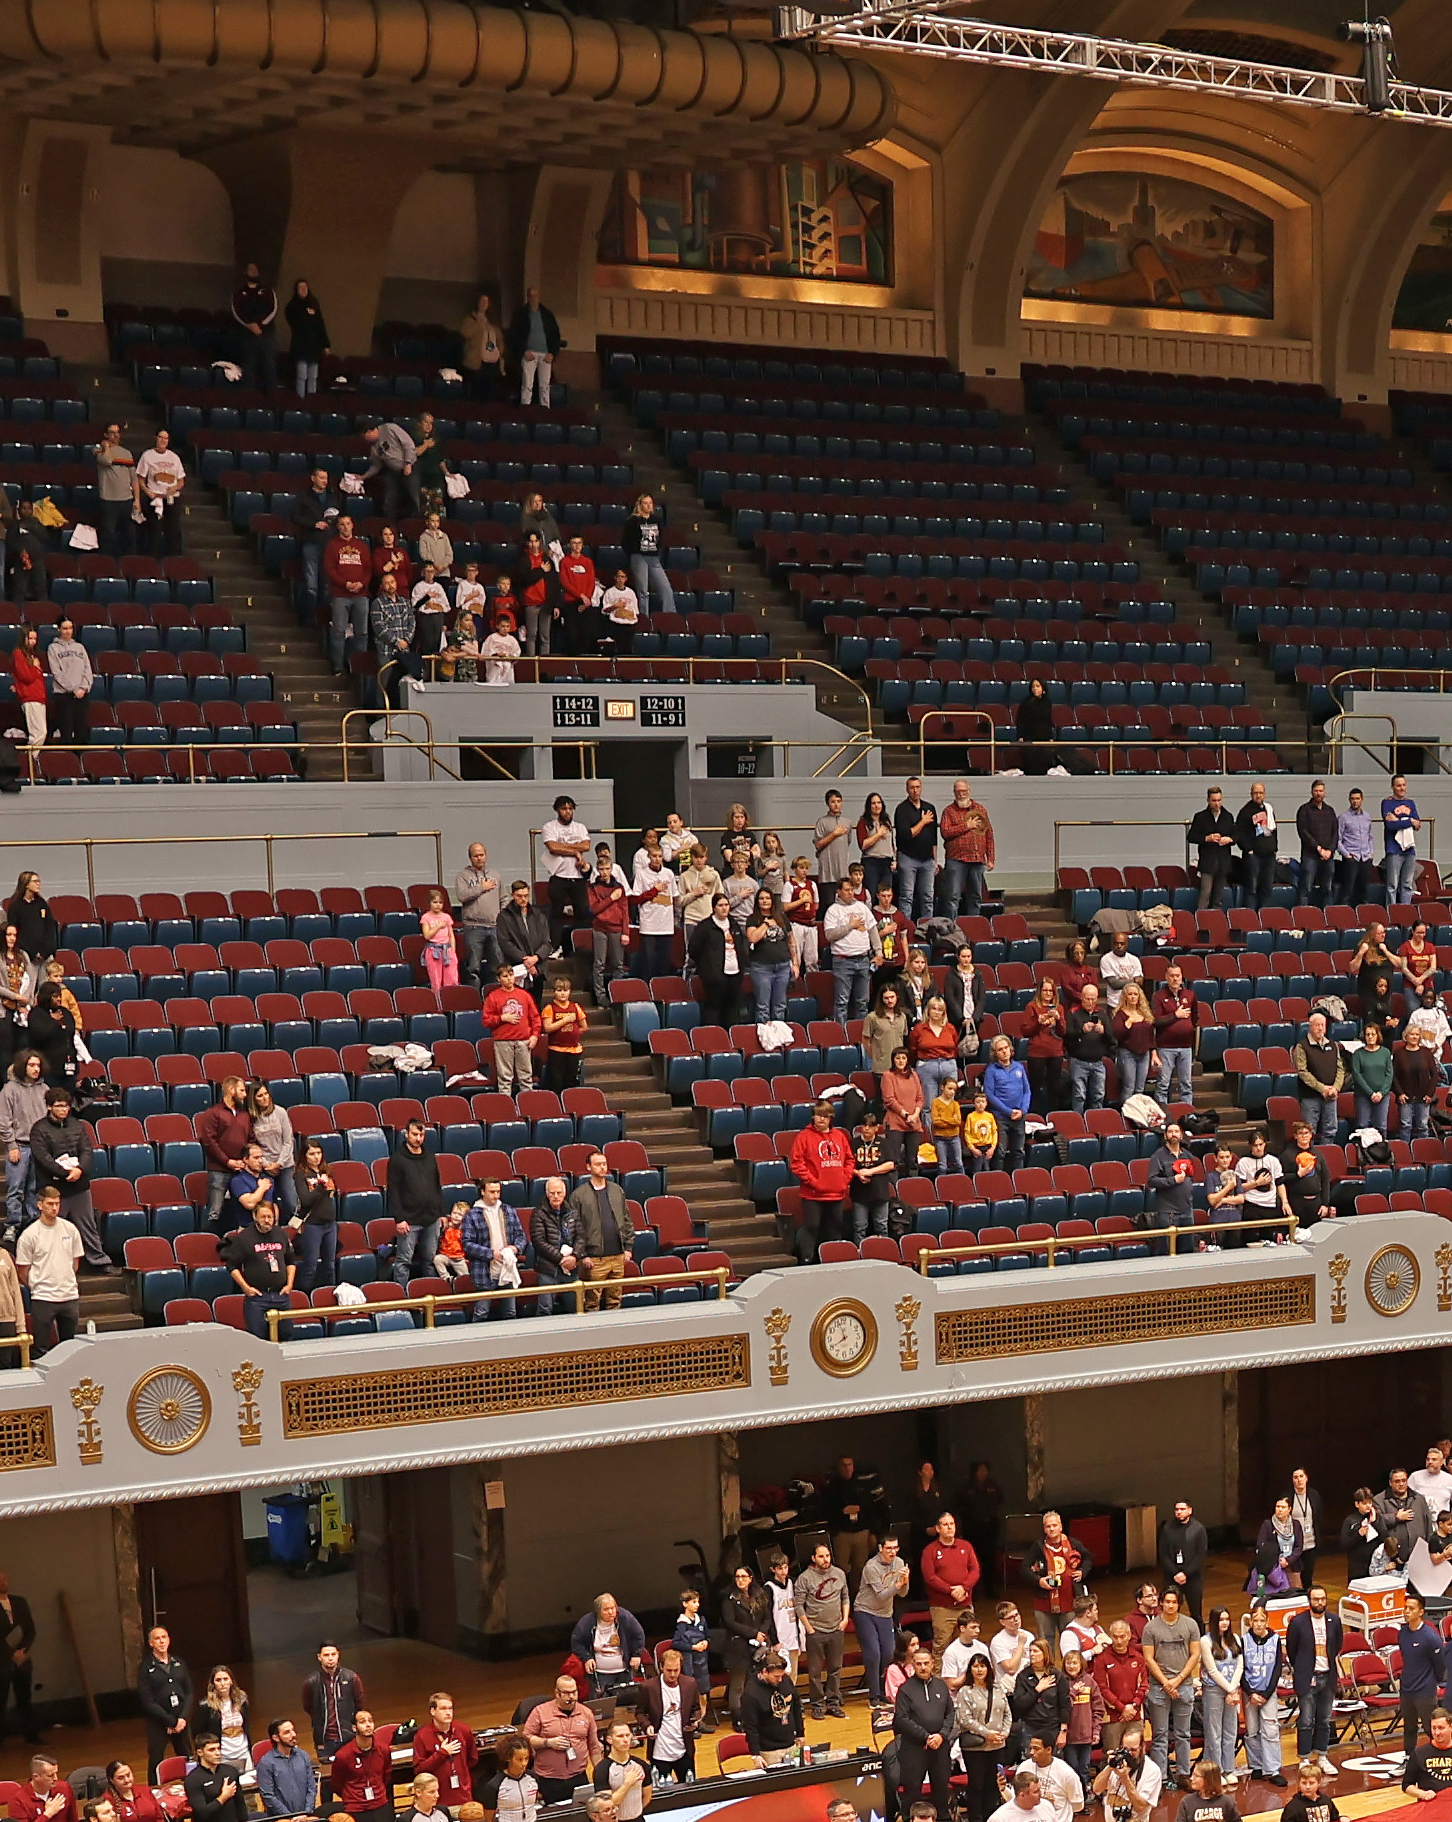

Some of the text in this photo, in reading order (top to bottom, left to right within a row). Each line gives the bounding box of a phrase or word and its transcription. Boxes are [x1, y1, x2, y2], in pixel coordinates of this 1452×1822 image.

[565, 698, 593, 709] 14-12
[647, 698, 674, 709] 12-10
[612, 704, 629, 716] EXIT
[564, 713, 592, 724] 13-11
[651, 713, 675, 724] 11-9
[816, 1578, 837, 1600] C
[1381, 1593, 1394, 1610] G
[1252, 1665, 1267, 1677] 31
[861, 1761, 883, 1772] anc
[1194, 1808, 1224, 1822] CHARGE
